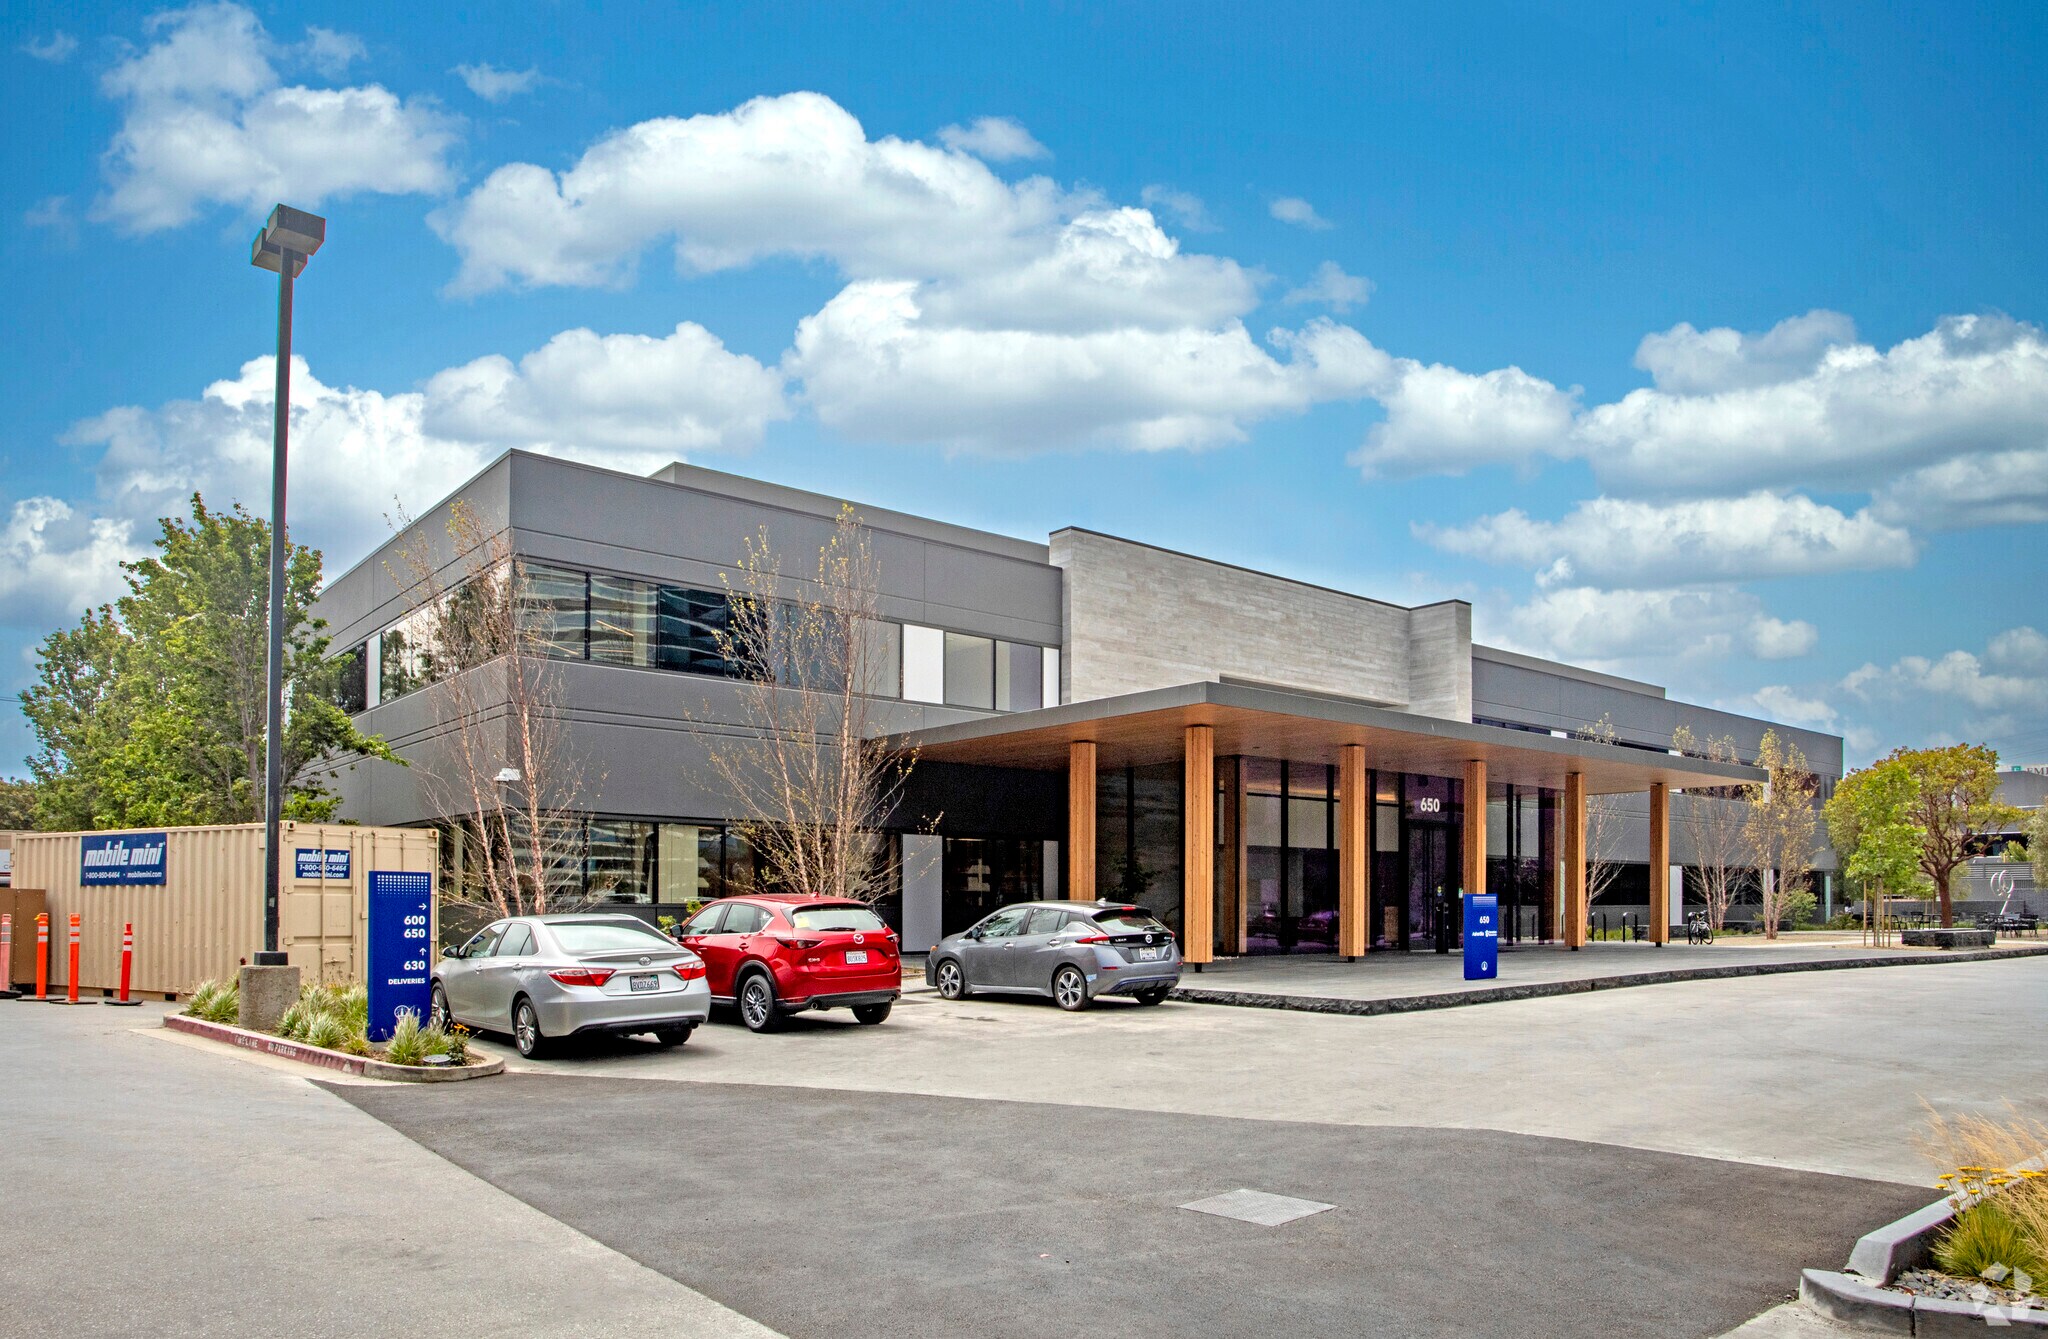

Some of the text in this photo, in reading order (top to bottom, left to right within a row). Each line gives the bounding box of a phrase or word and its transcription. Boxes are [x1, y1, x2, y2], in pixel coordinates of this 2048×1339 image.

[1420, 797, 1440, 813] 650
[84, 840, 163, 866] mobile mini
[328, 852, 348, 863] mini
[127, 870, 162, 878] mobilemini.com
[404, 915, 426, 926] 600
[1479, 915, 1490, 924] 650
[404, 928, 426, 939] 650
[404, 960, 426, 971] 630
[388, 977, 426, 985] DELIVERIES
[274, 1043, 297, 1057] PARKING
